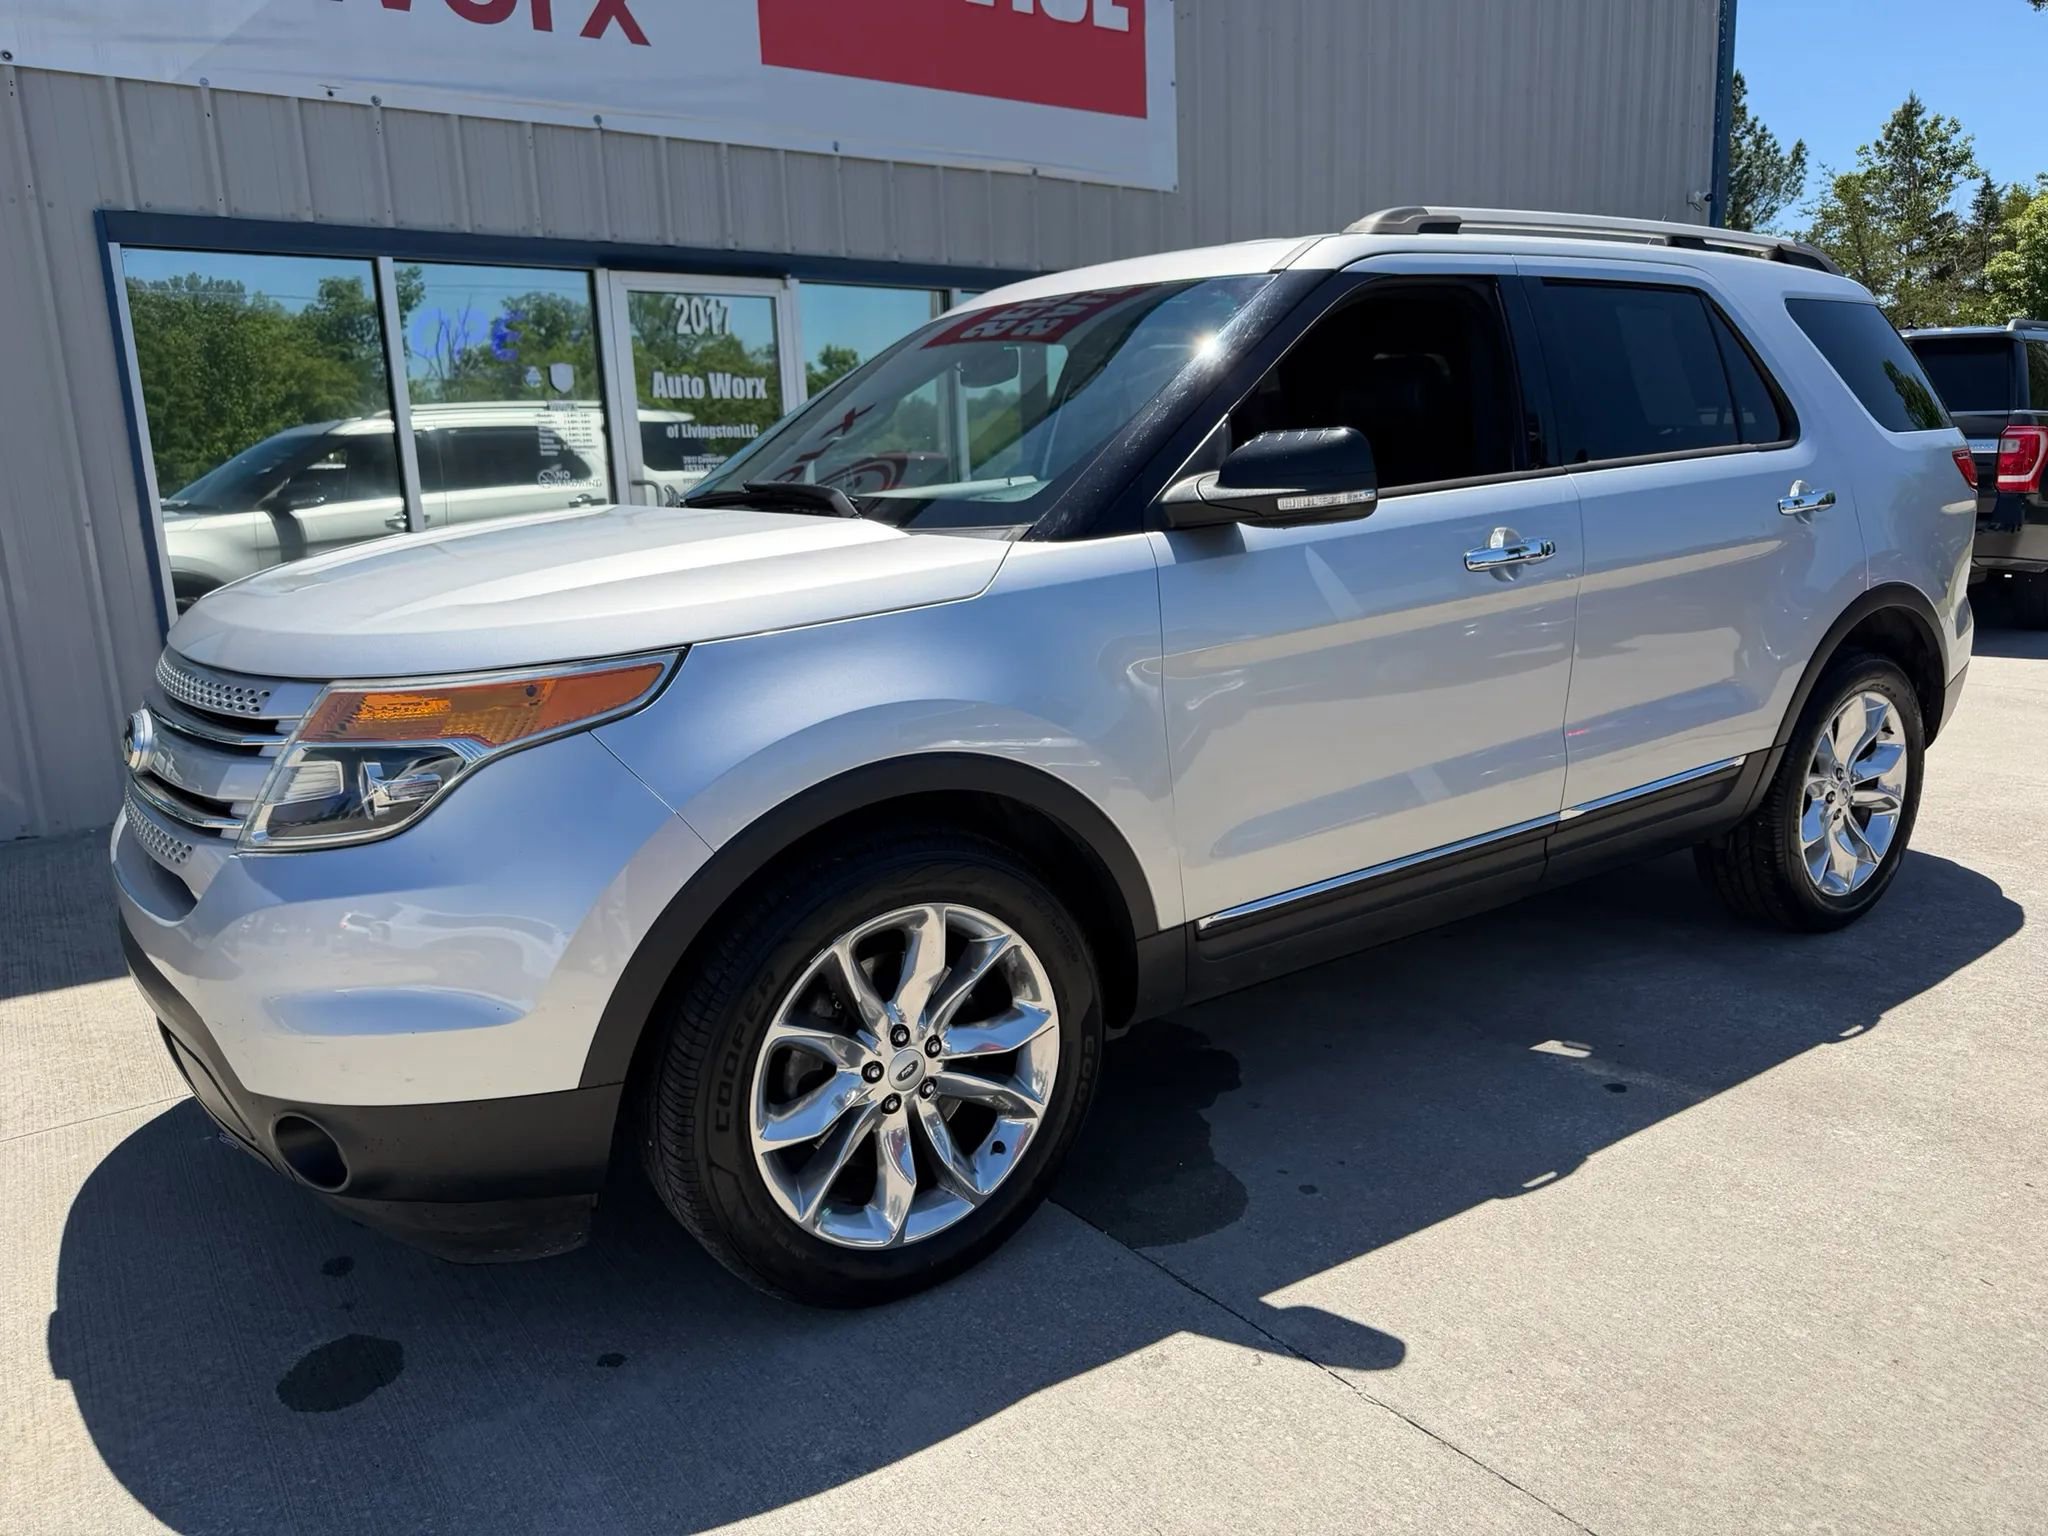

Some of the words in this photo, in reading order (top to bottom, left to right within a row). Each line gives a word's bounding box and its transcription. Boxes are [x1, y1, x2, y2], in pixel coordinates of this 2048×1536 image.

[675, 296, 731, 336] 2017
[652, 371, 706, 400] Auto
[707, 371, 769, 400] Worx
[666, 424, 679, 439] of
[681, 423, 759, 440] LivingstonLLC
[715, 969, 776, 1133] COOPER
